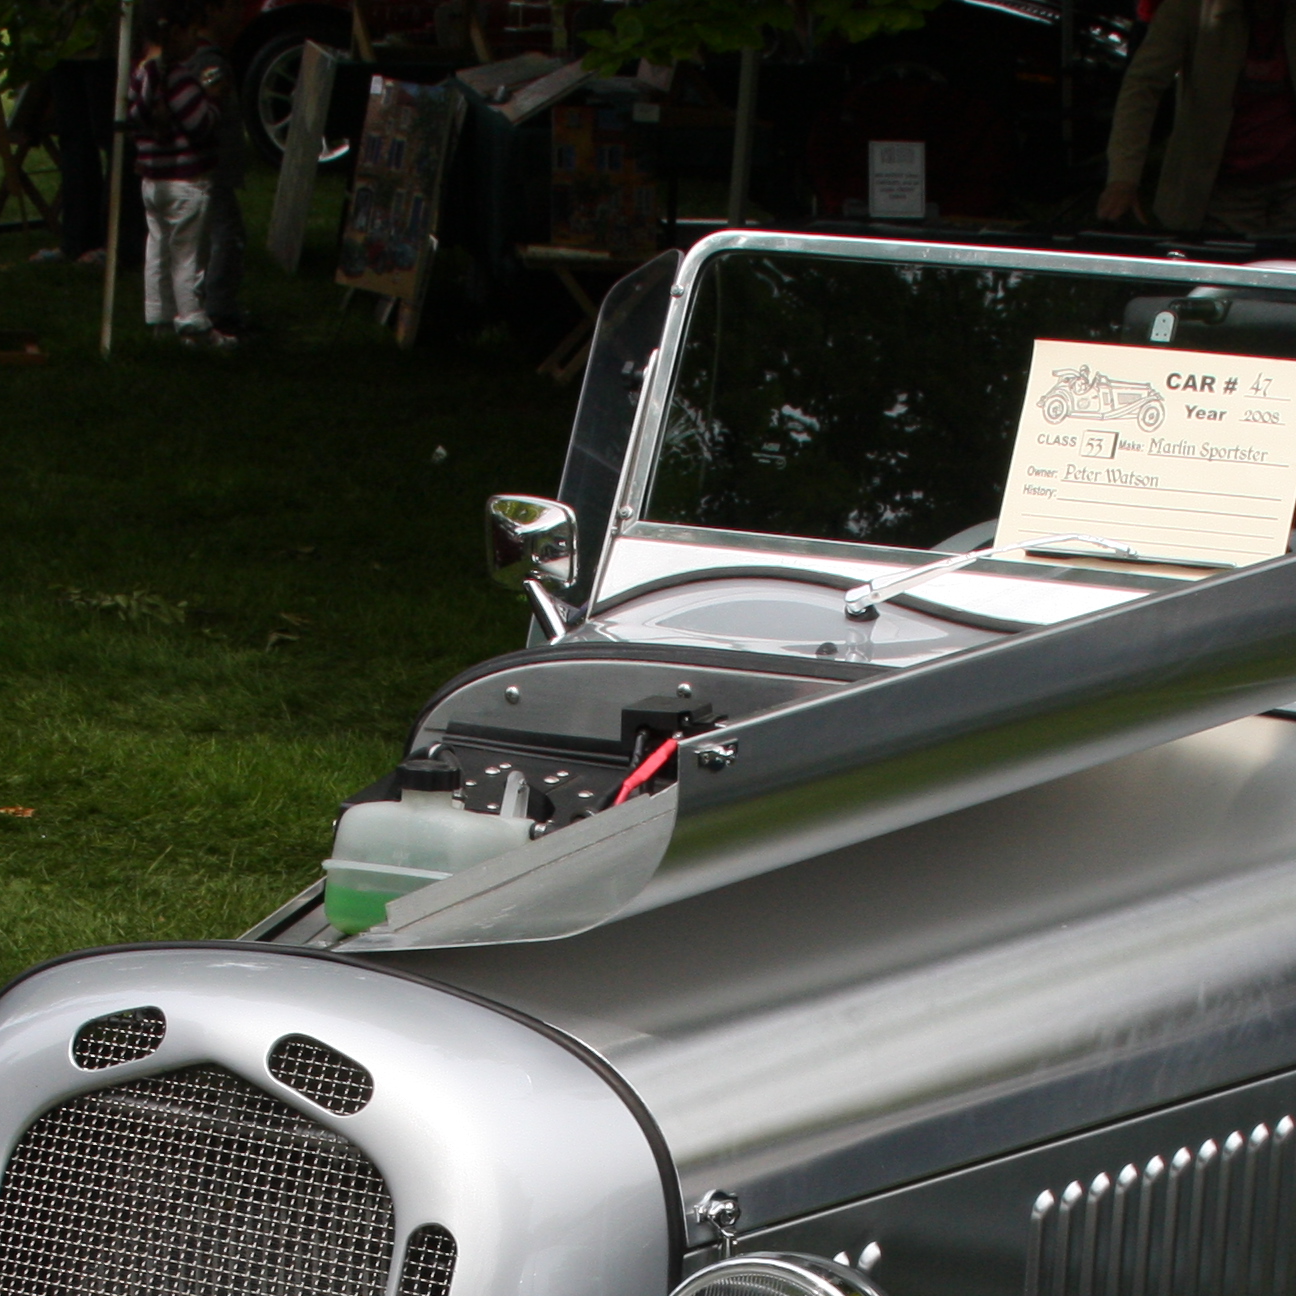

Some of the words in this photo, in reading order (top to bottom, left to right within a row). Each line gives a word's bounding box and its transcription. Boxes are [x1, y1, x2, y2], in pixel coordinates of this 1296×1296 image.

[1166, 372, 1217, 394] CAR
[1222, 377, 1239, 395] #
[1185, 404, 1227, 422] Year
[1244, 409, 1280, 424] 2008
[1036, 433, 1078, 448] CLASS
[1084, 437, 1104, 457] 53
[1118, 439, 1146, 453] Make:
[1147, 437, 1196, 456] Marlin
[1198, 441, 1269, 462] Sportster
[1026, 465, 1058, 479] Owner:
[1063, 463, 1103, 481] Peter
[1105, 467, 1160, 488] Watson
[1022, 483, 1058, 499] History:
